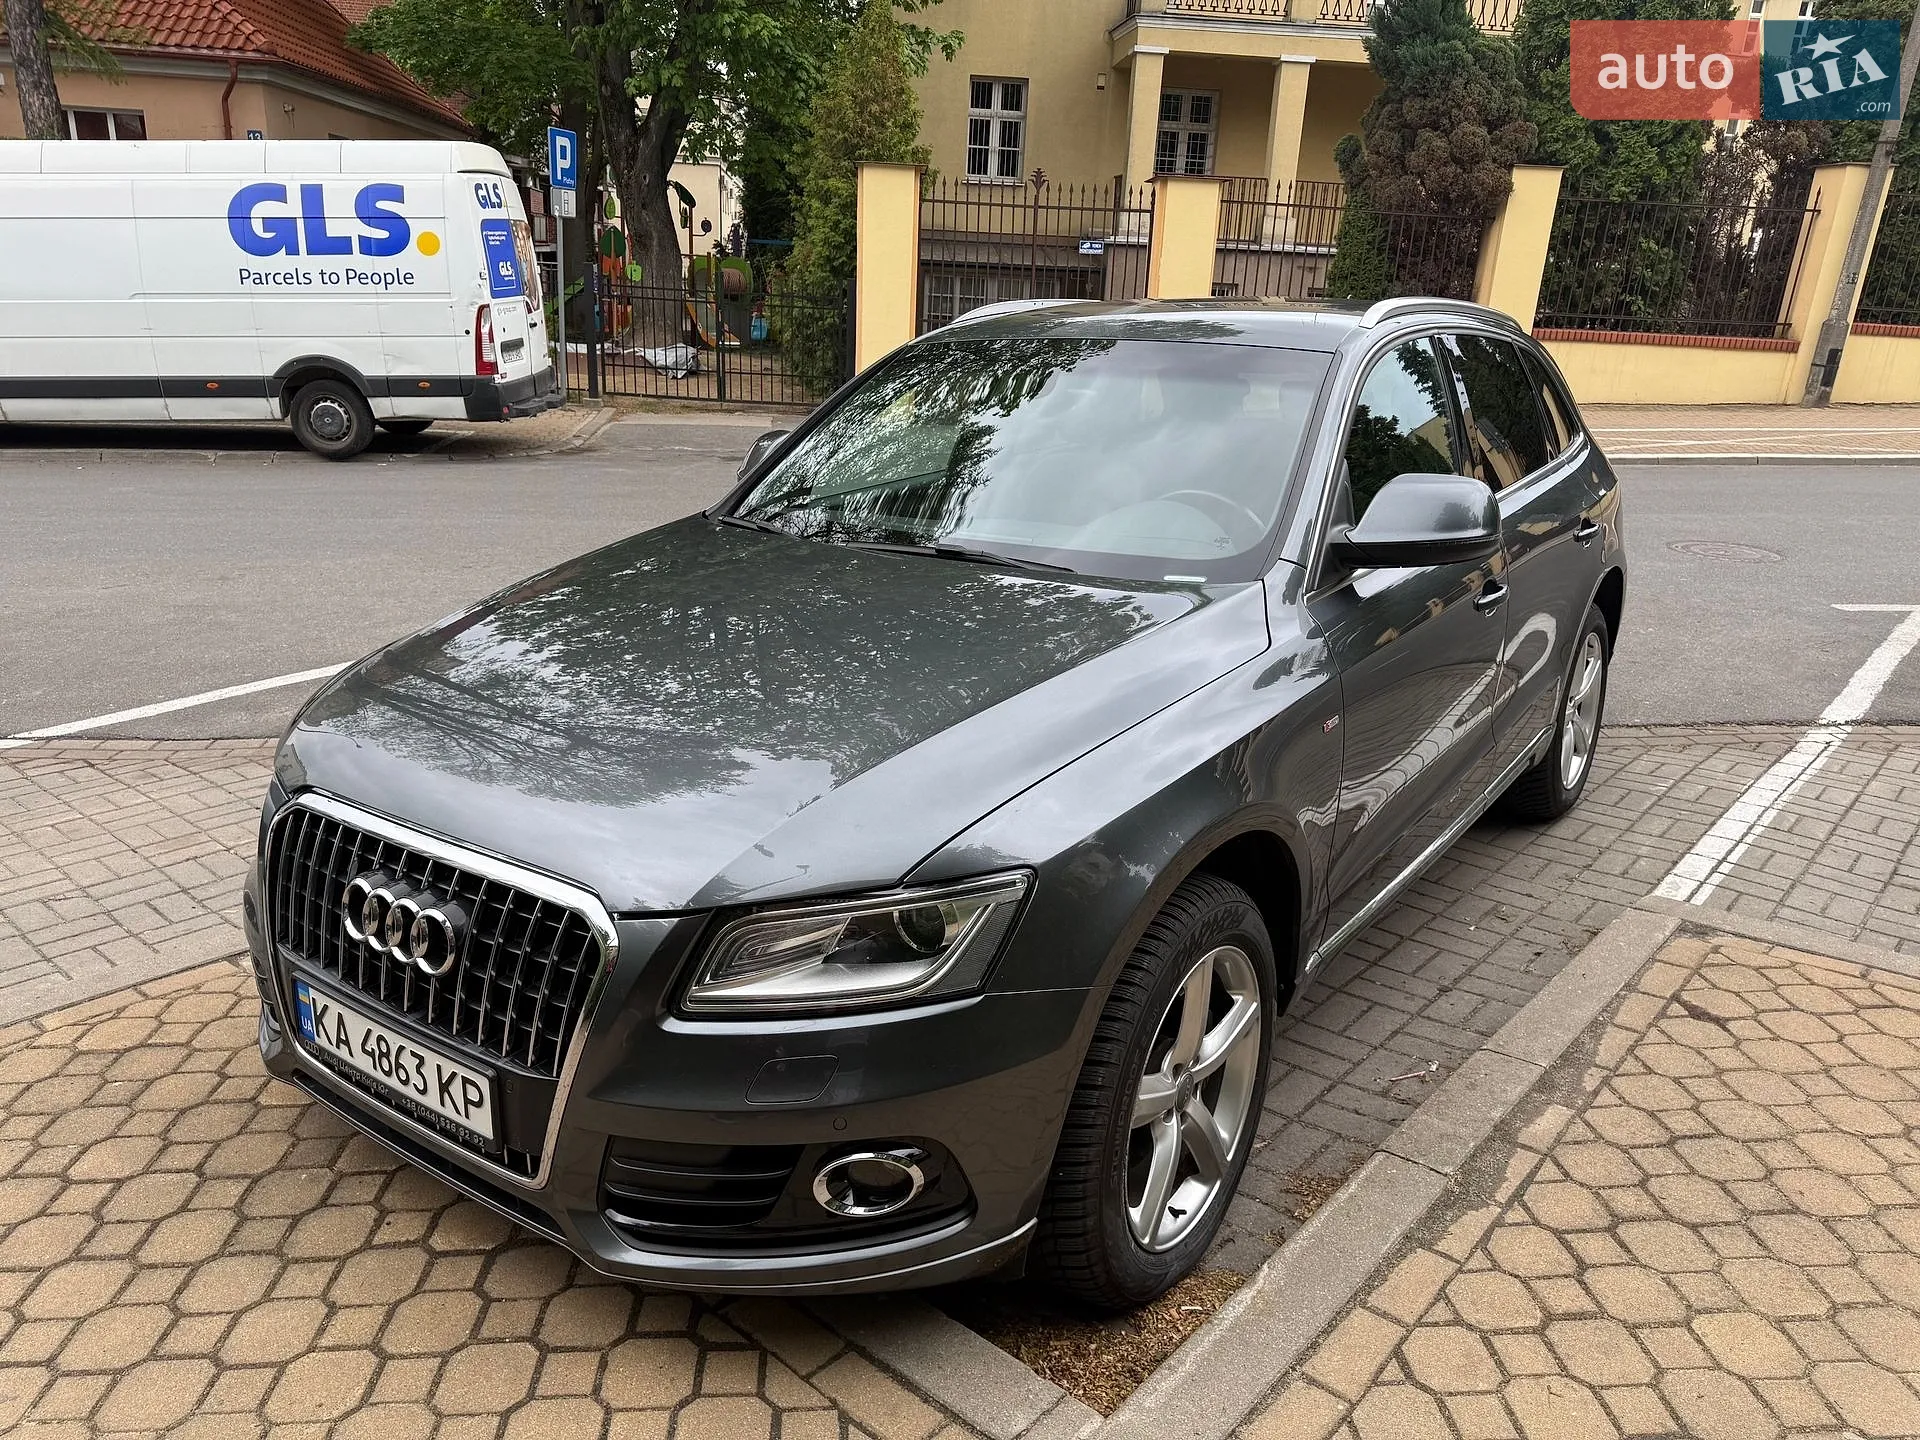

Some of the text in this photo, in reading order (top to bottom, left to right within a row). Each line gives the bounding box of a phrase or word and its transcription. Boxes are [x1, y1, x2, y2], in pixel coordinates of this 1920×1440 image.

[556, 135, 571, 180] P
[238, 267, 415, 290] Parcels to People
[302, 1015, 314, 1034] UA
[311, 997, 484, 1120] KA 4863 KP
[417, 1106, 439, 1124] (044)
